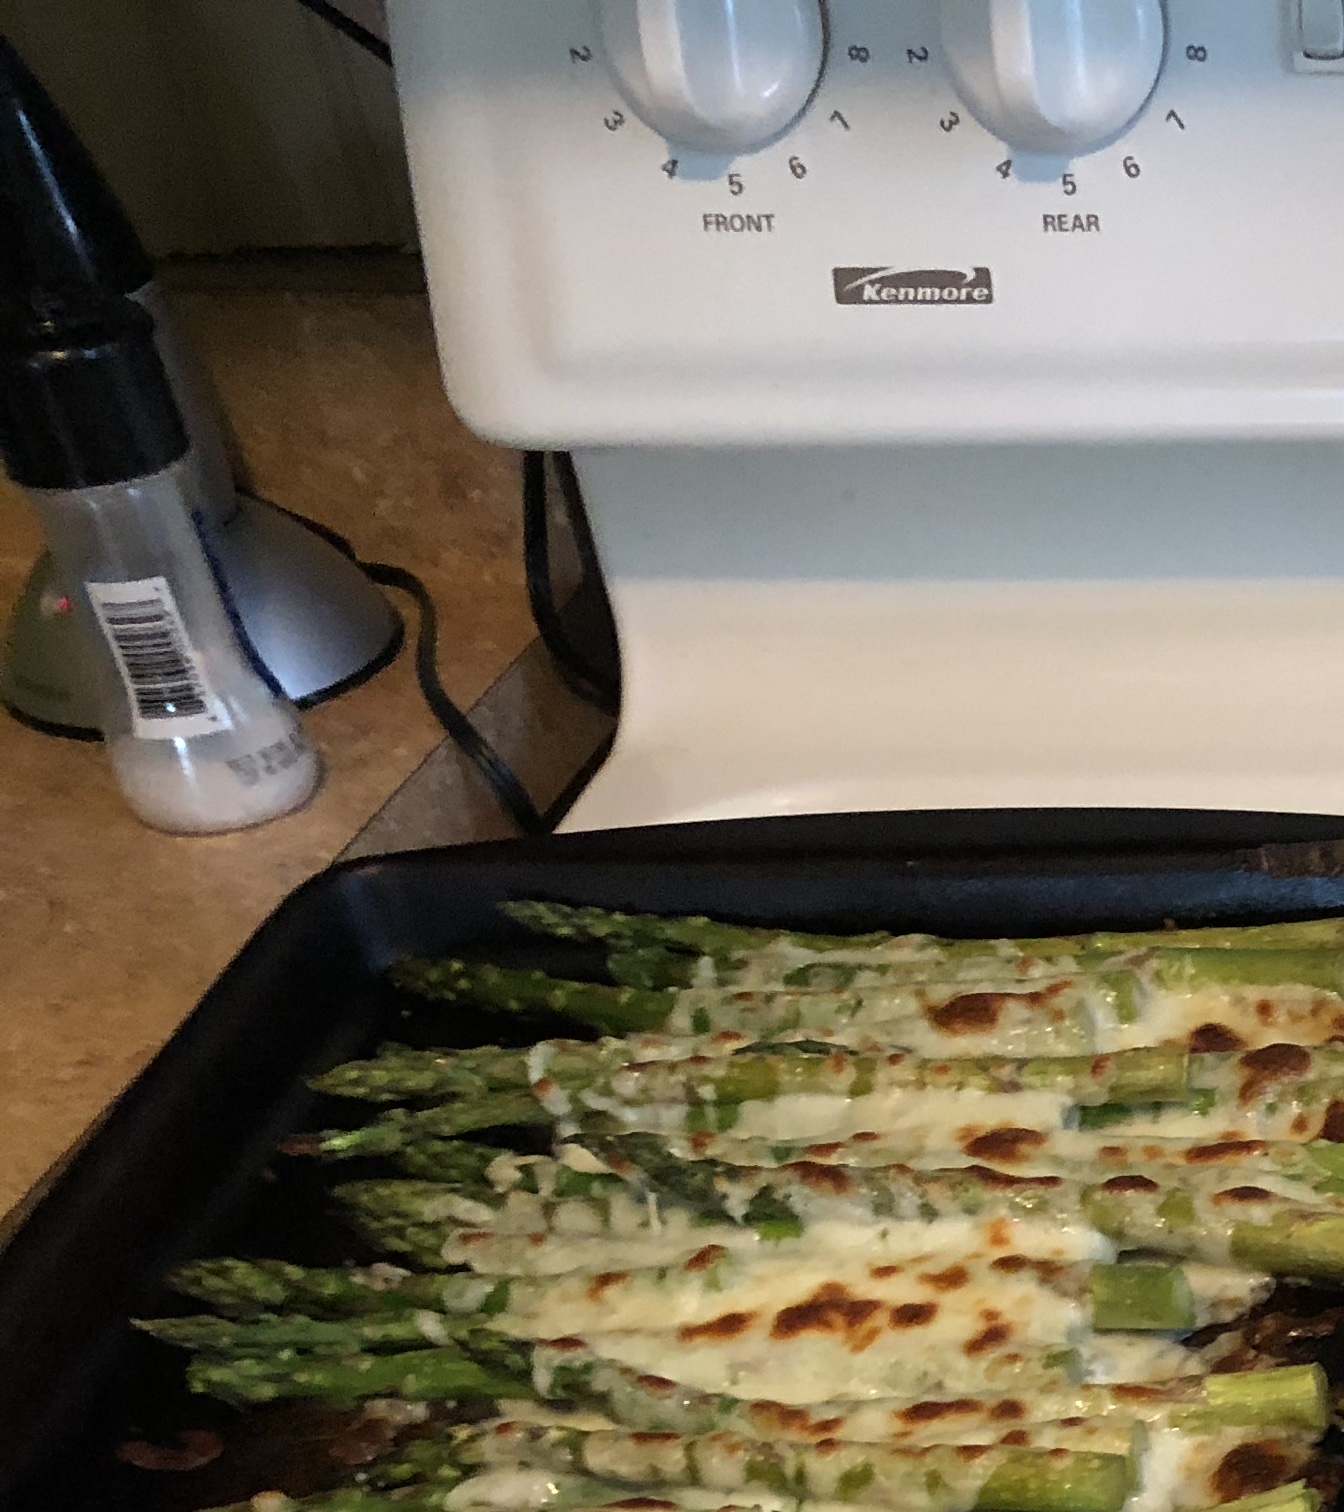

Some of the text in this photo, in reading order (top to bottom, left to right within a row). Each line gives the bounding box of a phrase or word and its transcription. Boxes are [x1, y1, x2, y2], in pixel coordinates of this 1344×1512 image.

[569, 46, 592, 63] 2
[848, 44, 871, 63] 8
[906, 46, 929, 63] 2
[1185, 44, 1208, 62] 8
[604, 110, 625, 131] 3
[829, 110, 850, 131] 7
[940, 111, 960, 132] 3
[1166, 109, 1185, 131] 7
[661, 159, 678, 179] 4
[788, 156, 807, 180] 6
[996, 159, 1012, 180] 4
[1122, 156, 1140, 179] 6
[728, 173, 743, 196] 5
[1062, 173, 1076, 196] 5
[702, 213, 775, 233] FRONT
[1042, 213, 1101, 233] REAR
[862, 283, 990, 301] Kenmore
